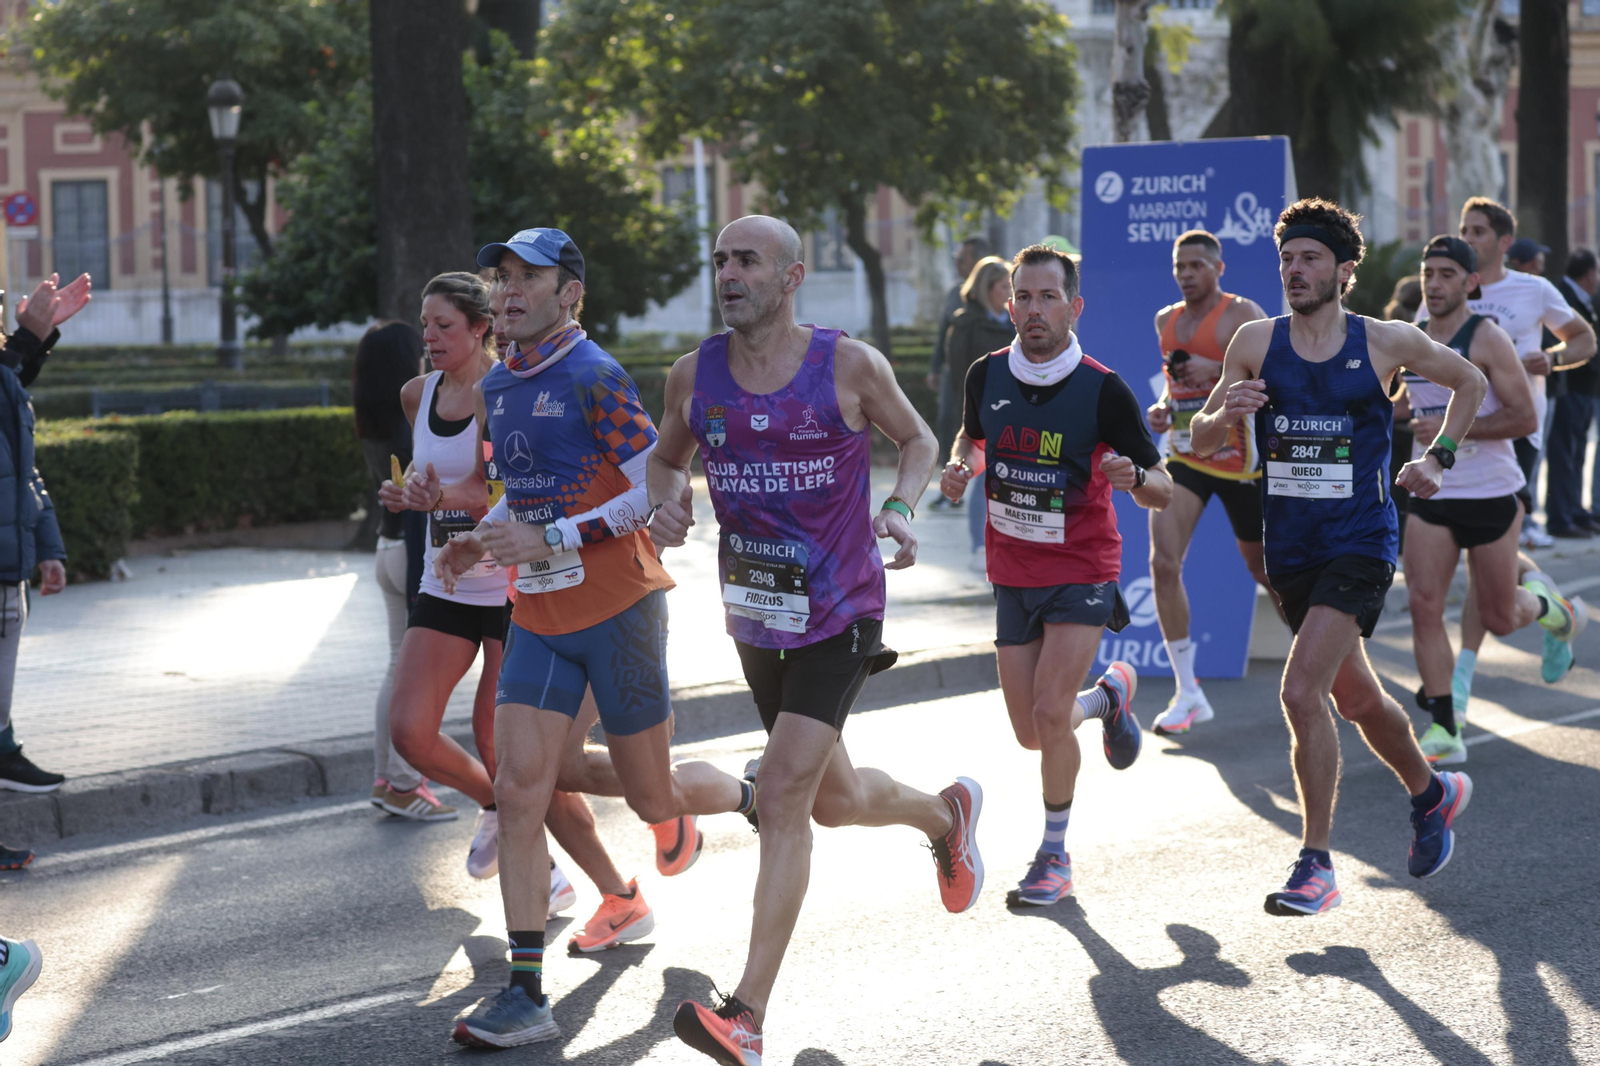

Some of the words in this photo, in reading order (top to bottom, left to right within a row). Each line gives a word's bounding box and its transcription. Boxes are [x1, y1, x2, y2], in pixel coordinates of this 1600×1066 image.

[1131, 174, 1206, 195] ZURICH
[1129, 198, 1207, 220] MARATÓN
[1291, 420, 1342, 431] ZURICH
[789, 431, 828, 440] Runners
[996, 425, 1063, 458] ADN
[1291, 445, 1321, 459] 2847
[707, 461, 738, 477] CLUB
[742, 455, 835, 476] ATLETISMO
[1291, 466, 1322, 477] QUECO
[709, 475, 760, 493] PLAYAS
[765, 478, 789, 493] DE
[794, 470, 835, 491] LEPE
[1010, 468, 1056, 484] ZURICH
[1010, 490, 1037, 507] 2846
[444, 510, 470, 518] ZUR
[516, 507, 553, 524] ZURICH
[1004, 507, 1043, 524] MAESTRE
[745, 541, 796, 559] ZURICH
[529, 560, 551, 573] RUBIO
[749, 569, 775, 587] 2948
[744, 591, 784, 607] FIDELUS
[1098, 638, 1198, 668] URIC
